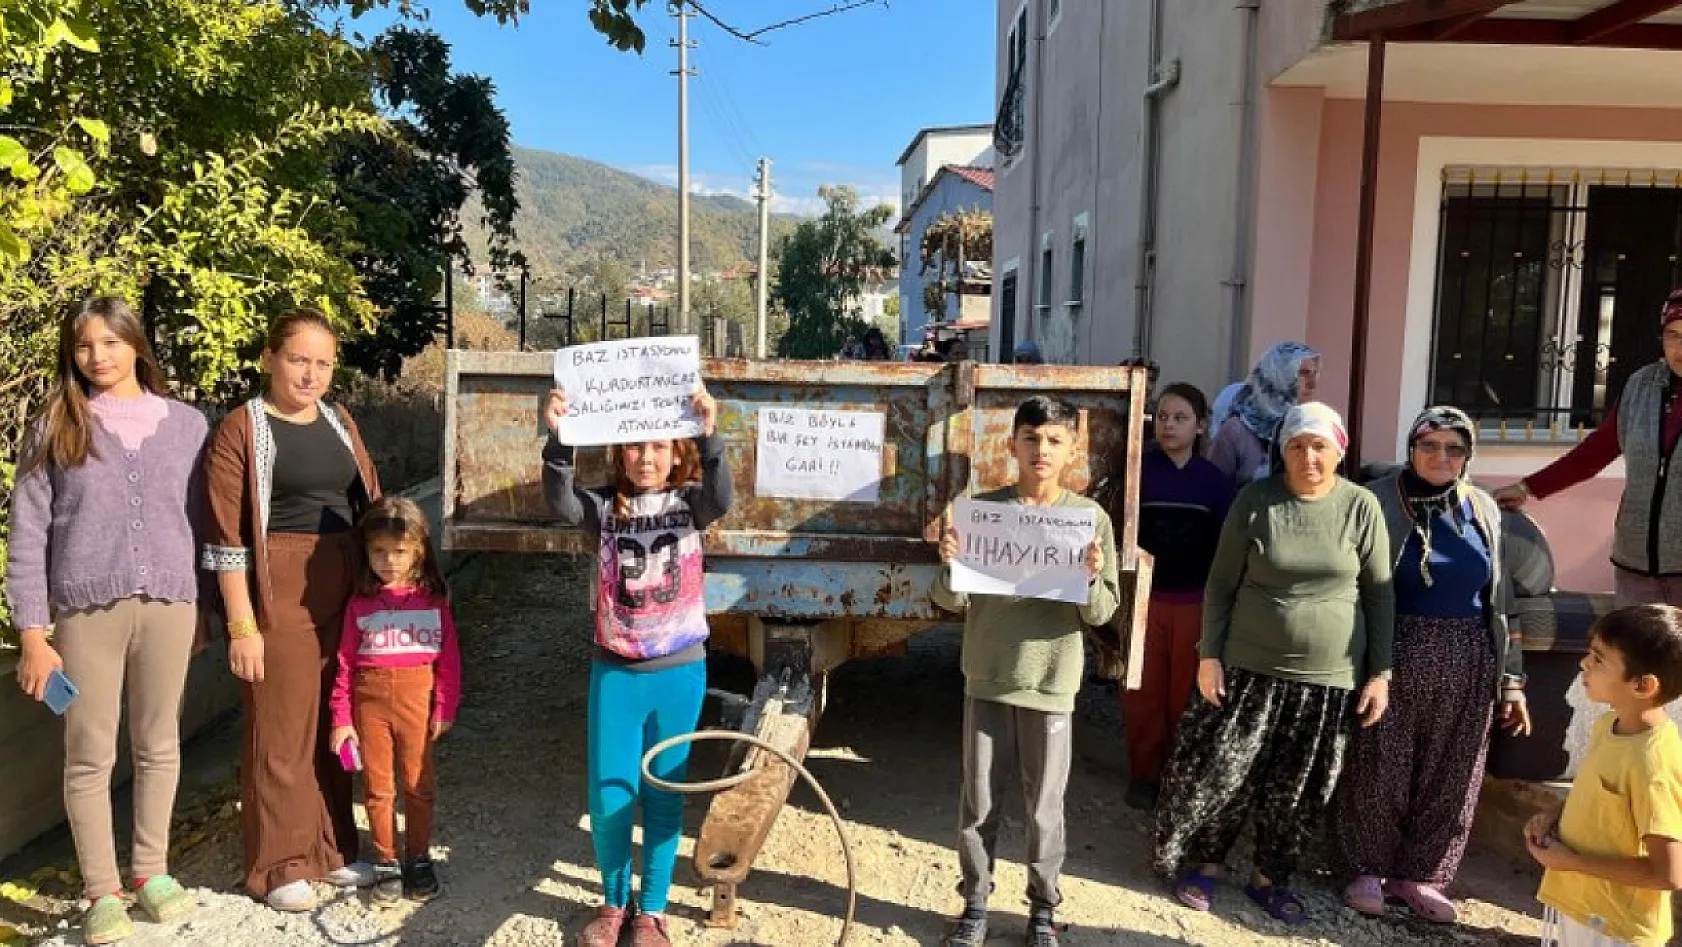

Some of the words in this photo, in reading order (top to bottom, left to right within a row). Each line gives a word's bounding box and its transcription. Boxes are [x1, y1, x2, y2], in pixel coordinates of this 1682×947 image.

[572, 350, 609, 366] BAZ
[970, 508, 1003, 523] BAZ
[617, 532, 681, 608] 23
[361, 622, 442, 649] adidas
